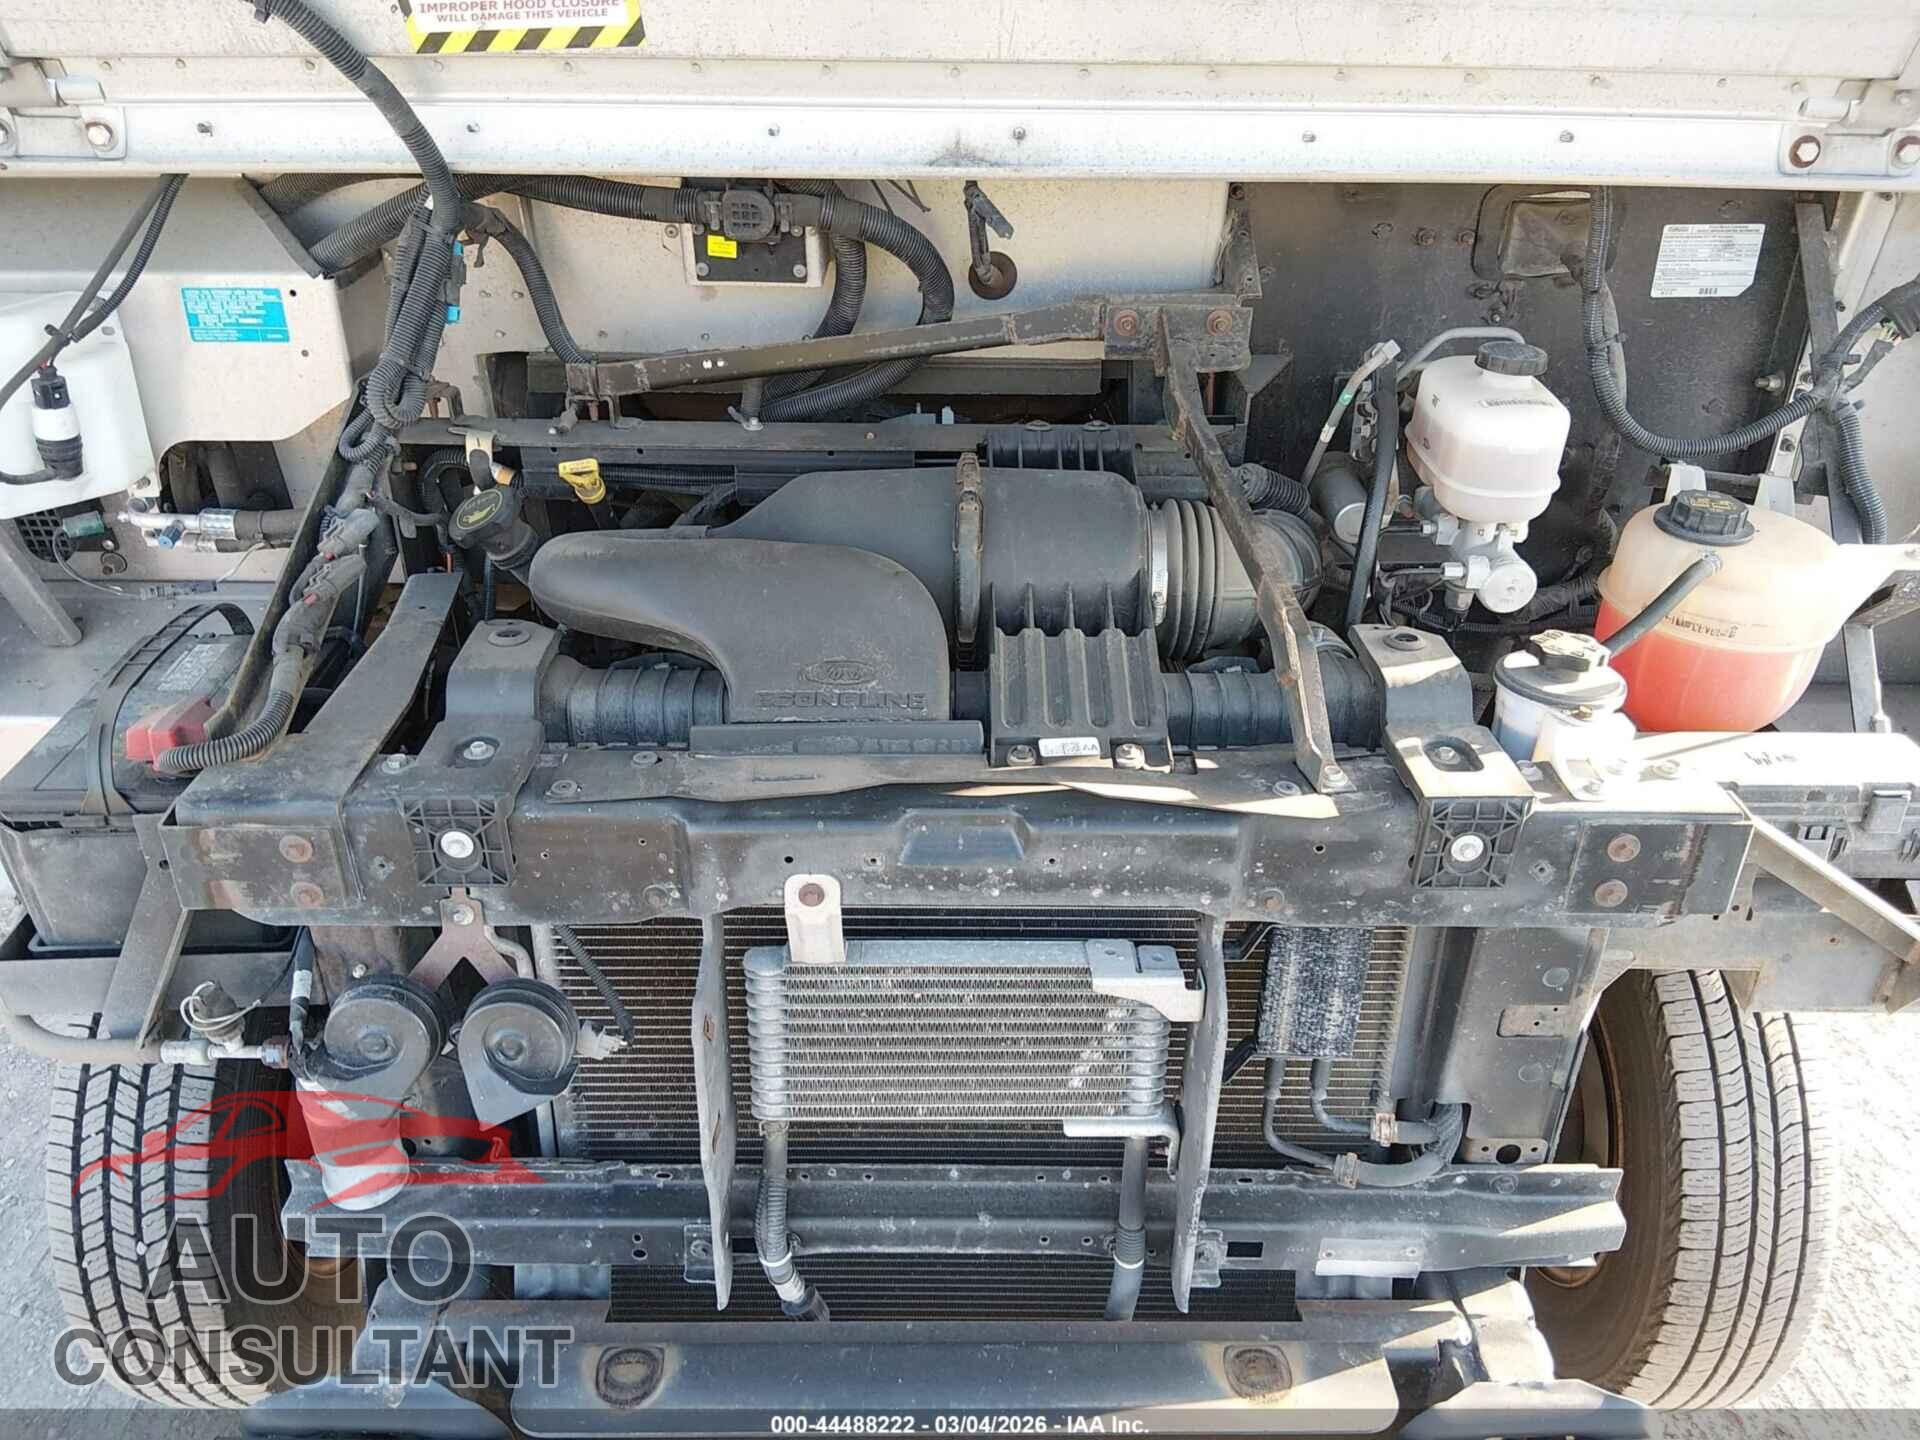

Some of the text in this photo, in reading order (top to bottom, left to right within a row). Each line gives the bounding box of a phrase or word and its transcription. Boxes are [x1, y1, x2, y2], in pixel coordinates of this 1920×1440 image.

[419, 0, 620, 14] IMPROPER HOOD CLOSURE
[436, 8, 609, 22] WILL DAMAGE THIS VEHICLE
